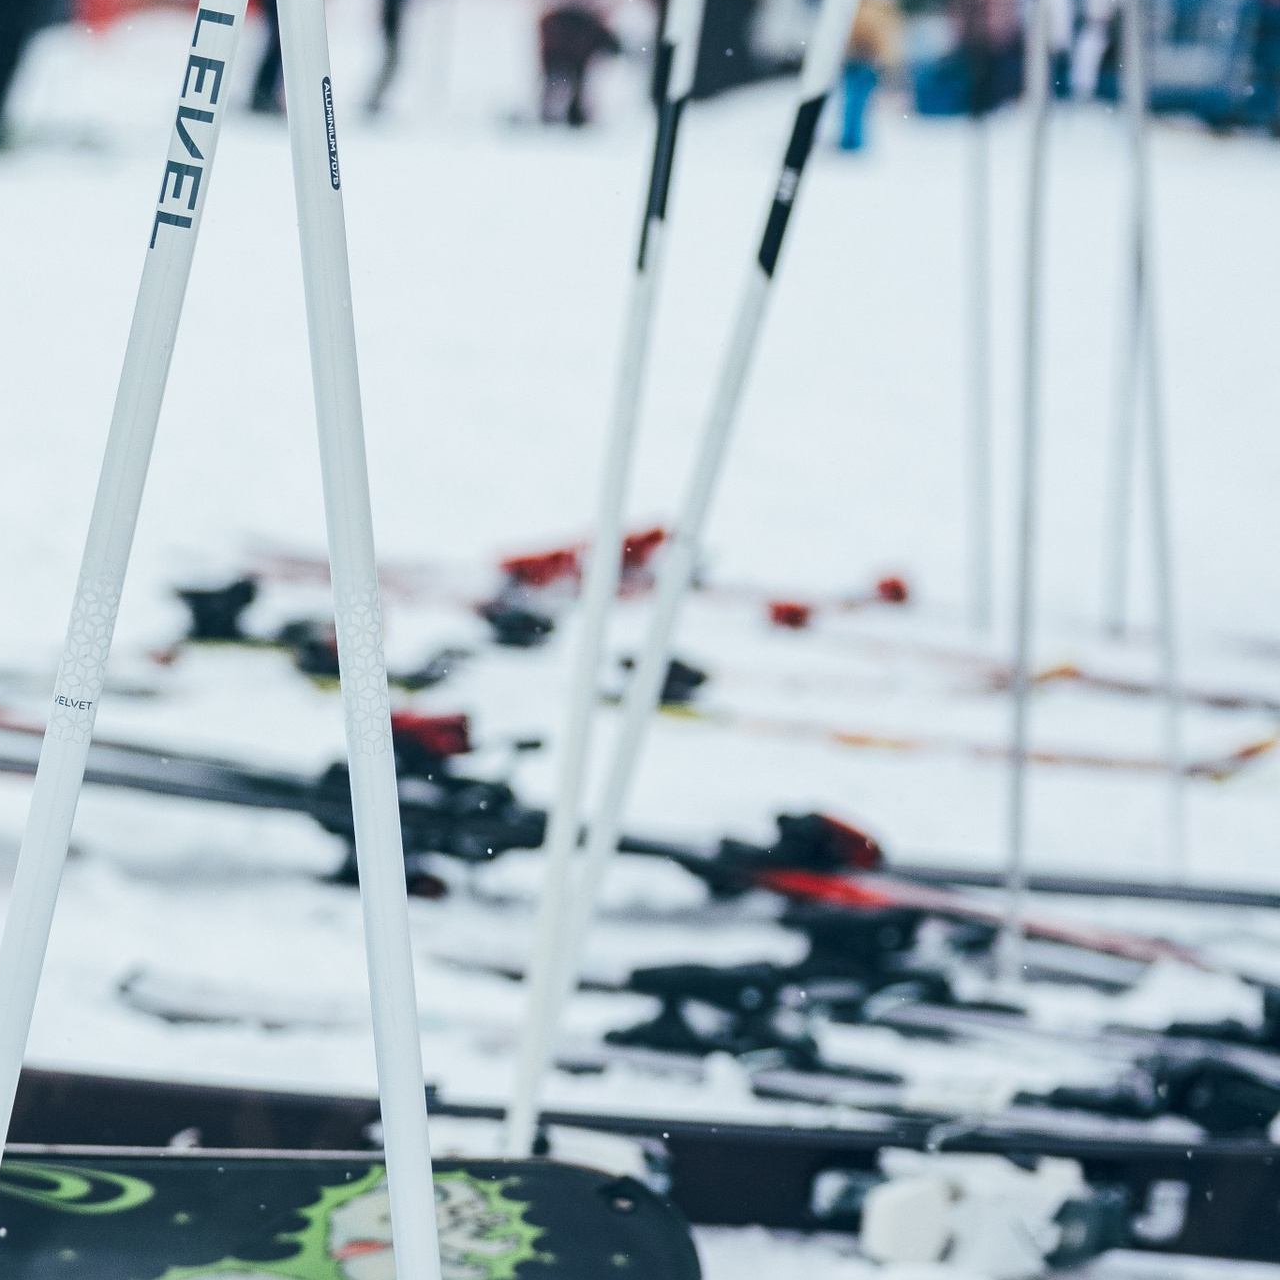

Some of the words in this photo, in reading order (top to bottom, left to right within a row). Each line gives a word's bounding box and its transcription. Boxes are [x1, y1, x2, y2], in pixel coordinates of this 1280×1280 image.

[149, 8, 235, 249] LEVEL
[323, 82, 336, 152] ALUMINIUM
[330, 154, 340, 185] 7075
[54, 693, 93, 711] VELVET
